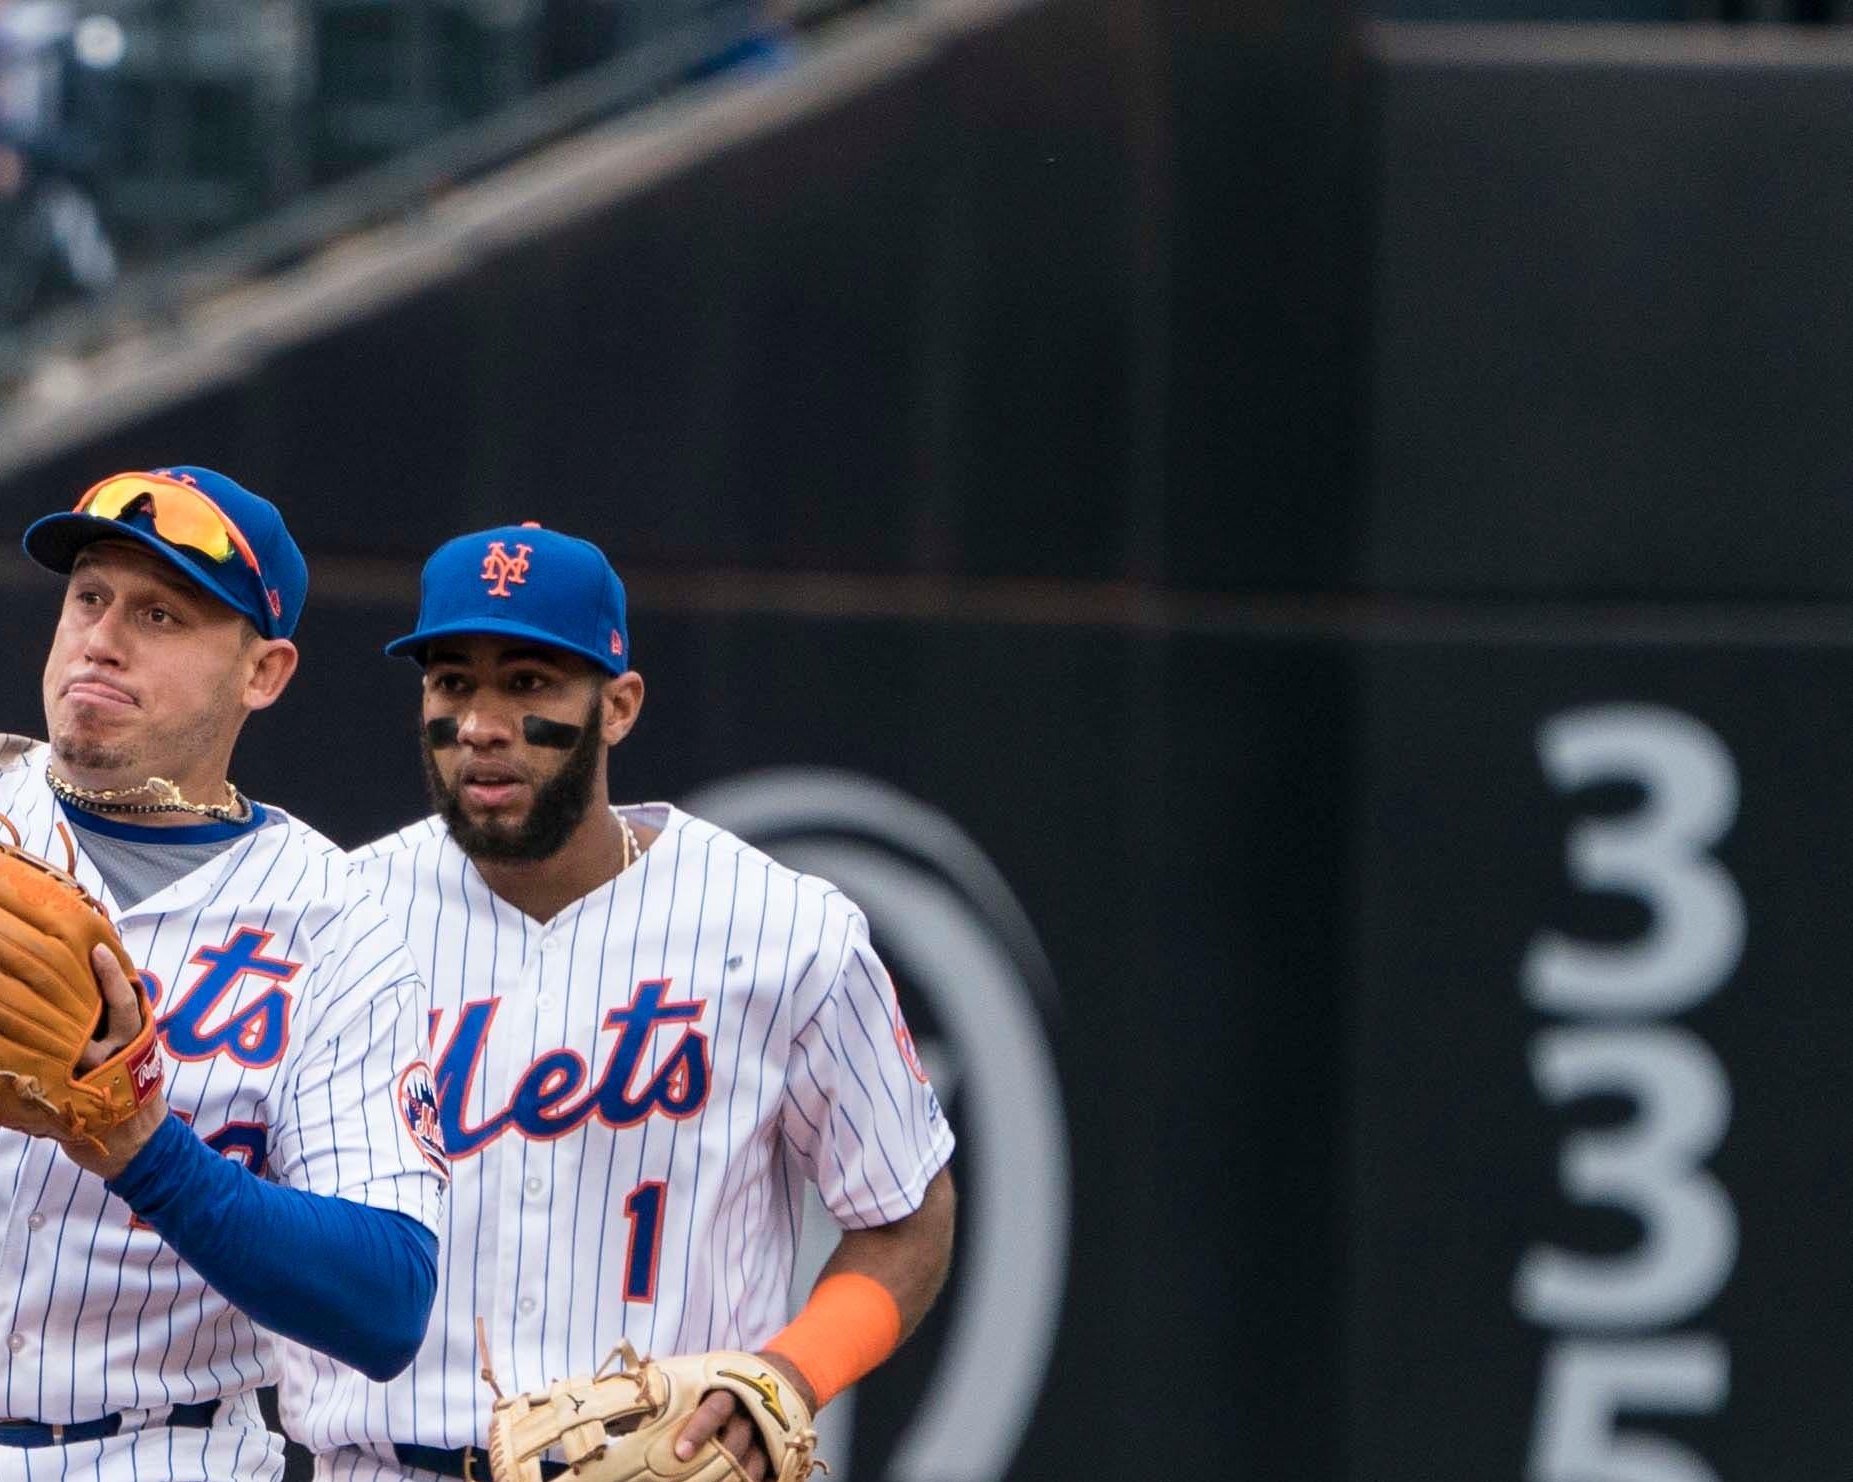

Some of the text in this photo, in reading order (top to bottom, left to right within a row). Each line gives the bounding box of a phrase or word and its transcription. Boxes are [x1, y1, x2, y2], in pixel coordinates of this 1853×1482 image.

[480, 541, 533, 597] NY
[136, 926, 304, 1070] ts
[621, 1179, 668, 1305] 1
